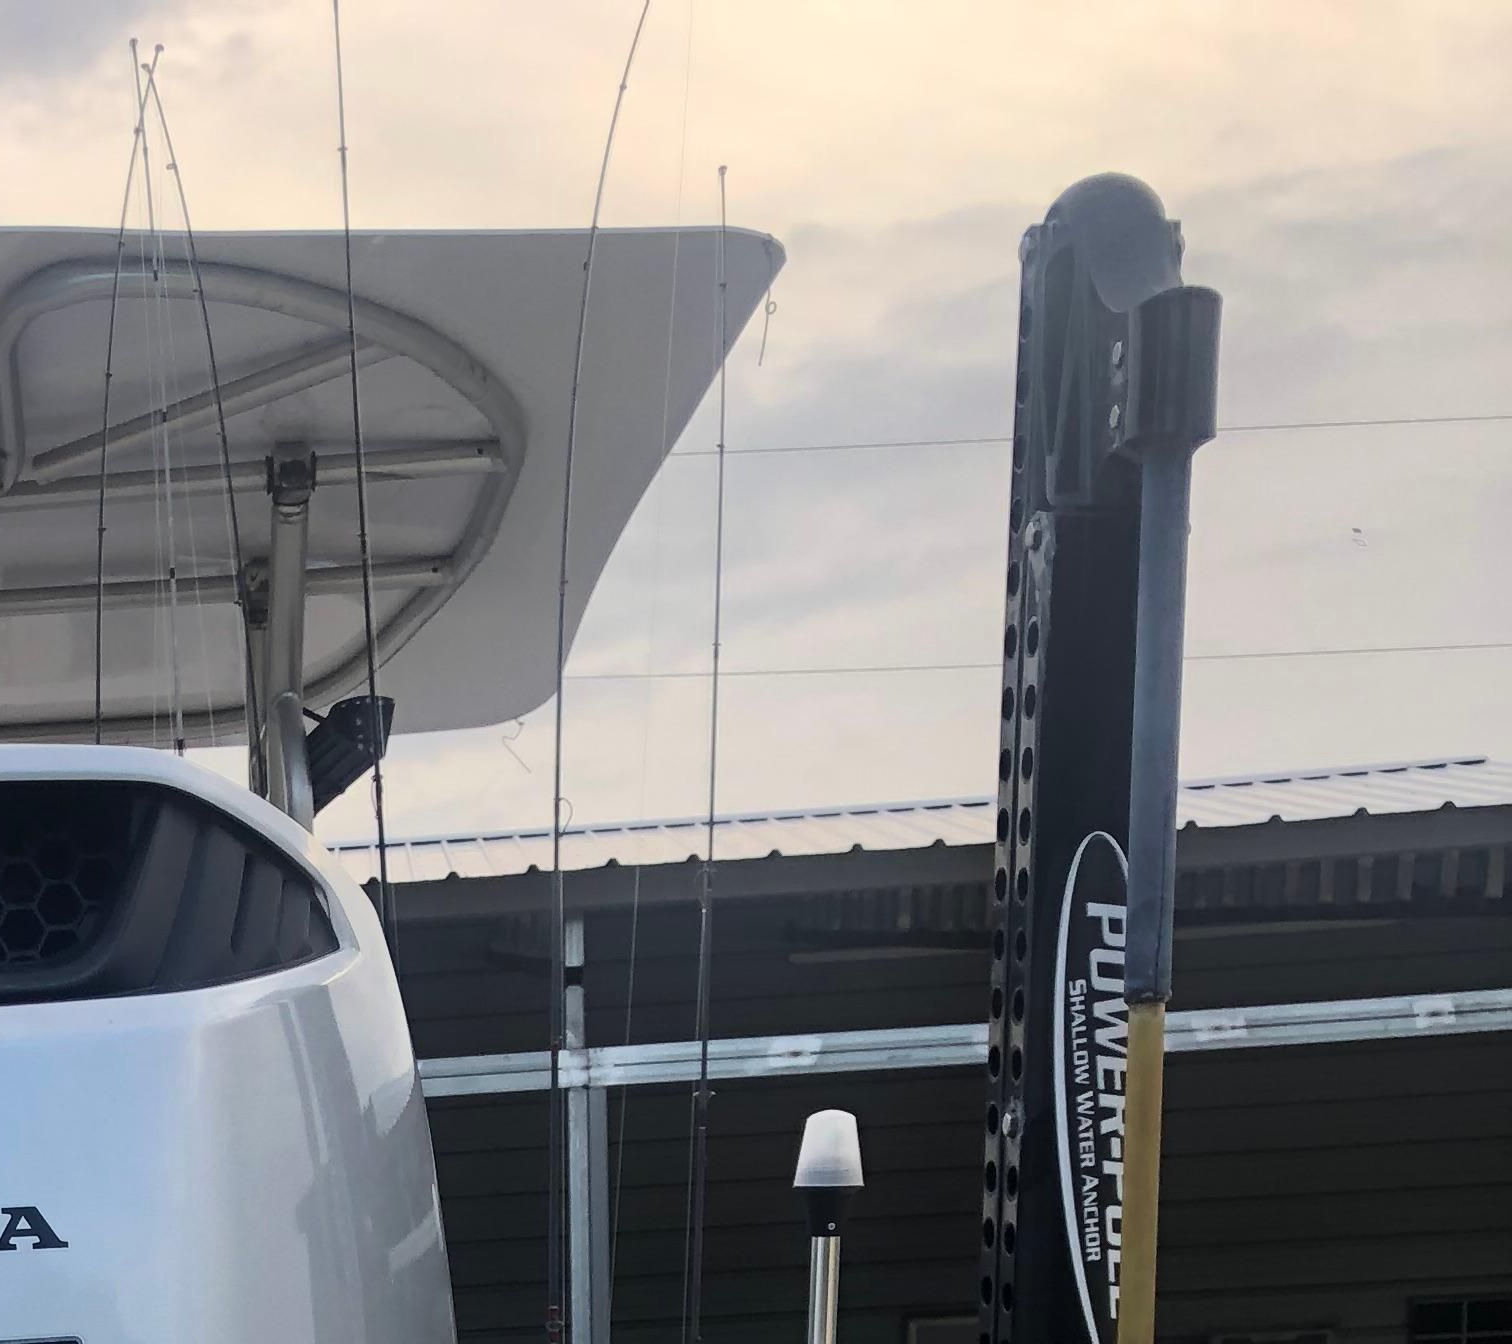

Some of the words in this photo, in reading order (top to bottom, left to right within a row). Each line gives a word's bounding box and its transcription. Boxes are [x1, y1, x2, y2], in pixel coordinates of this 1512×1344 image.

[1069, 978, 1089, 1085] SHALLOW
[1075, 1090, 1095, 1168] WATER
[1086, 902, 1129, 1319] POWER-
[1081, 1174, 1101, 1262] ANCHOR
